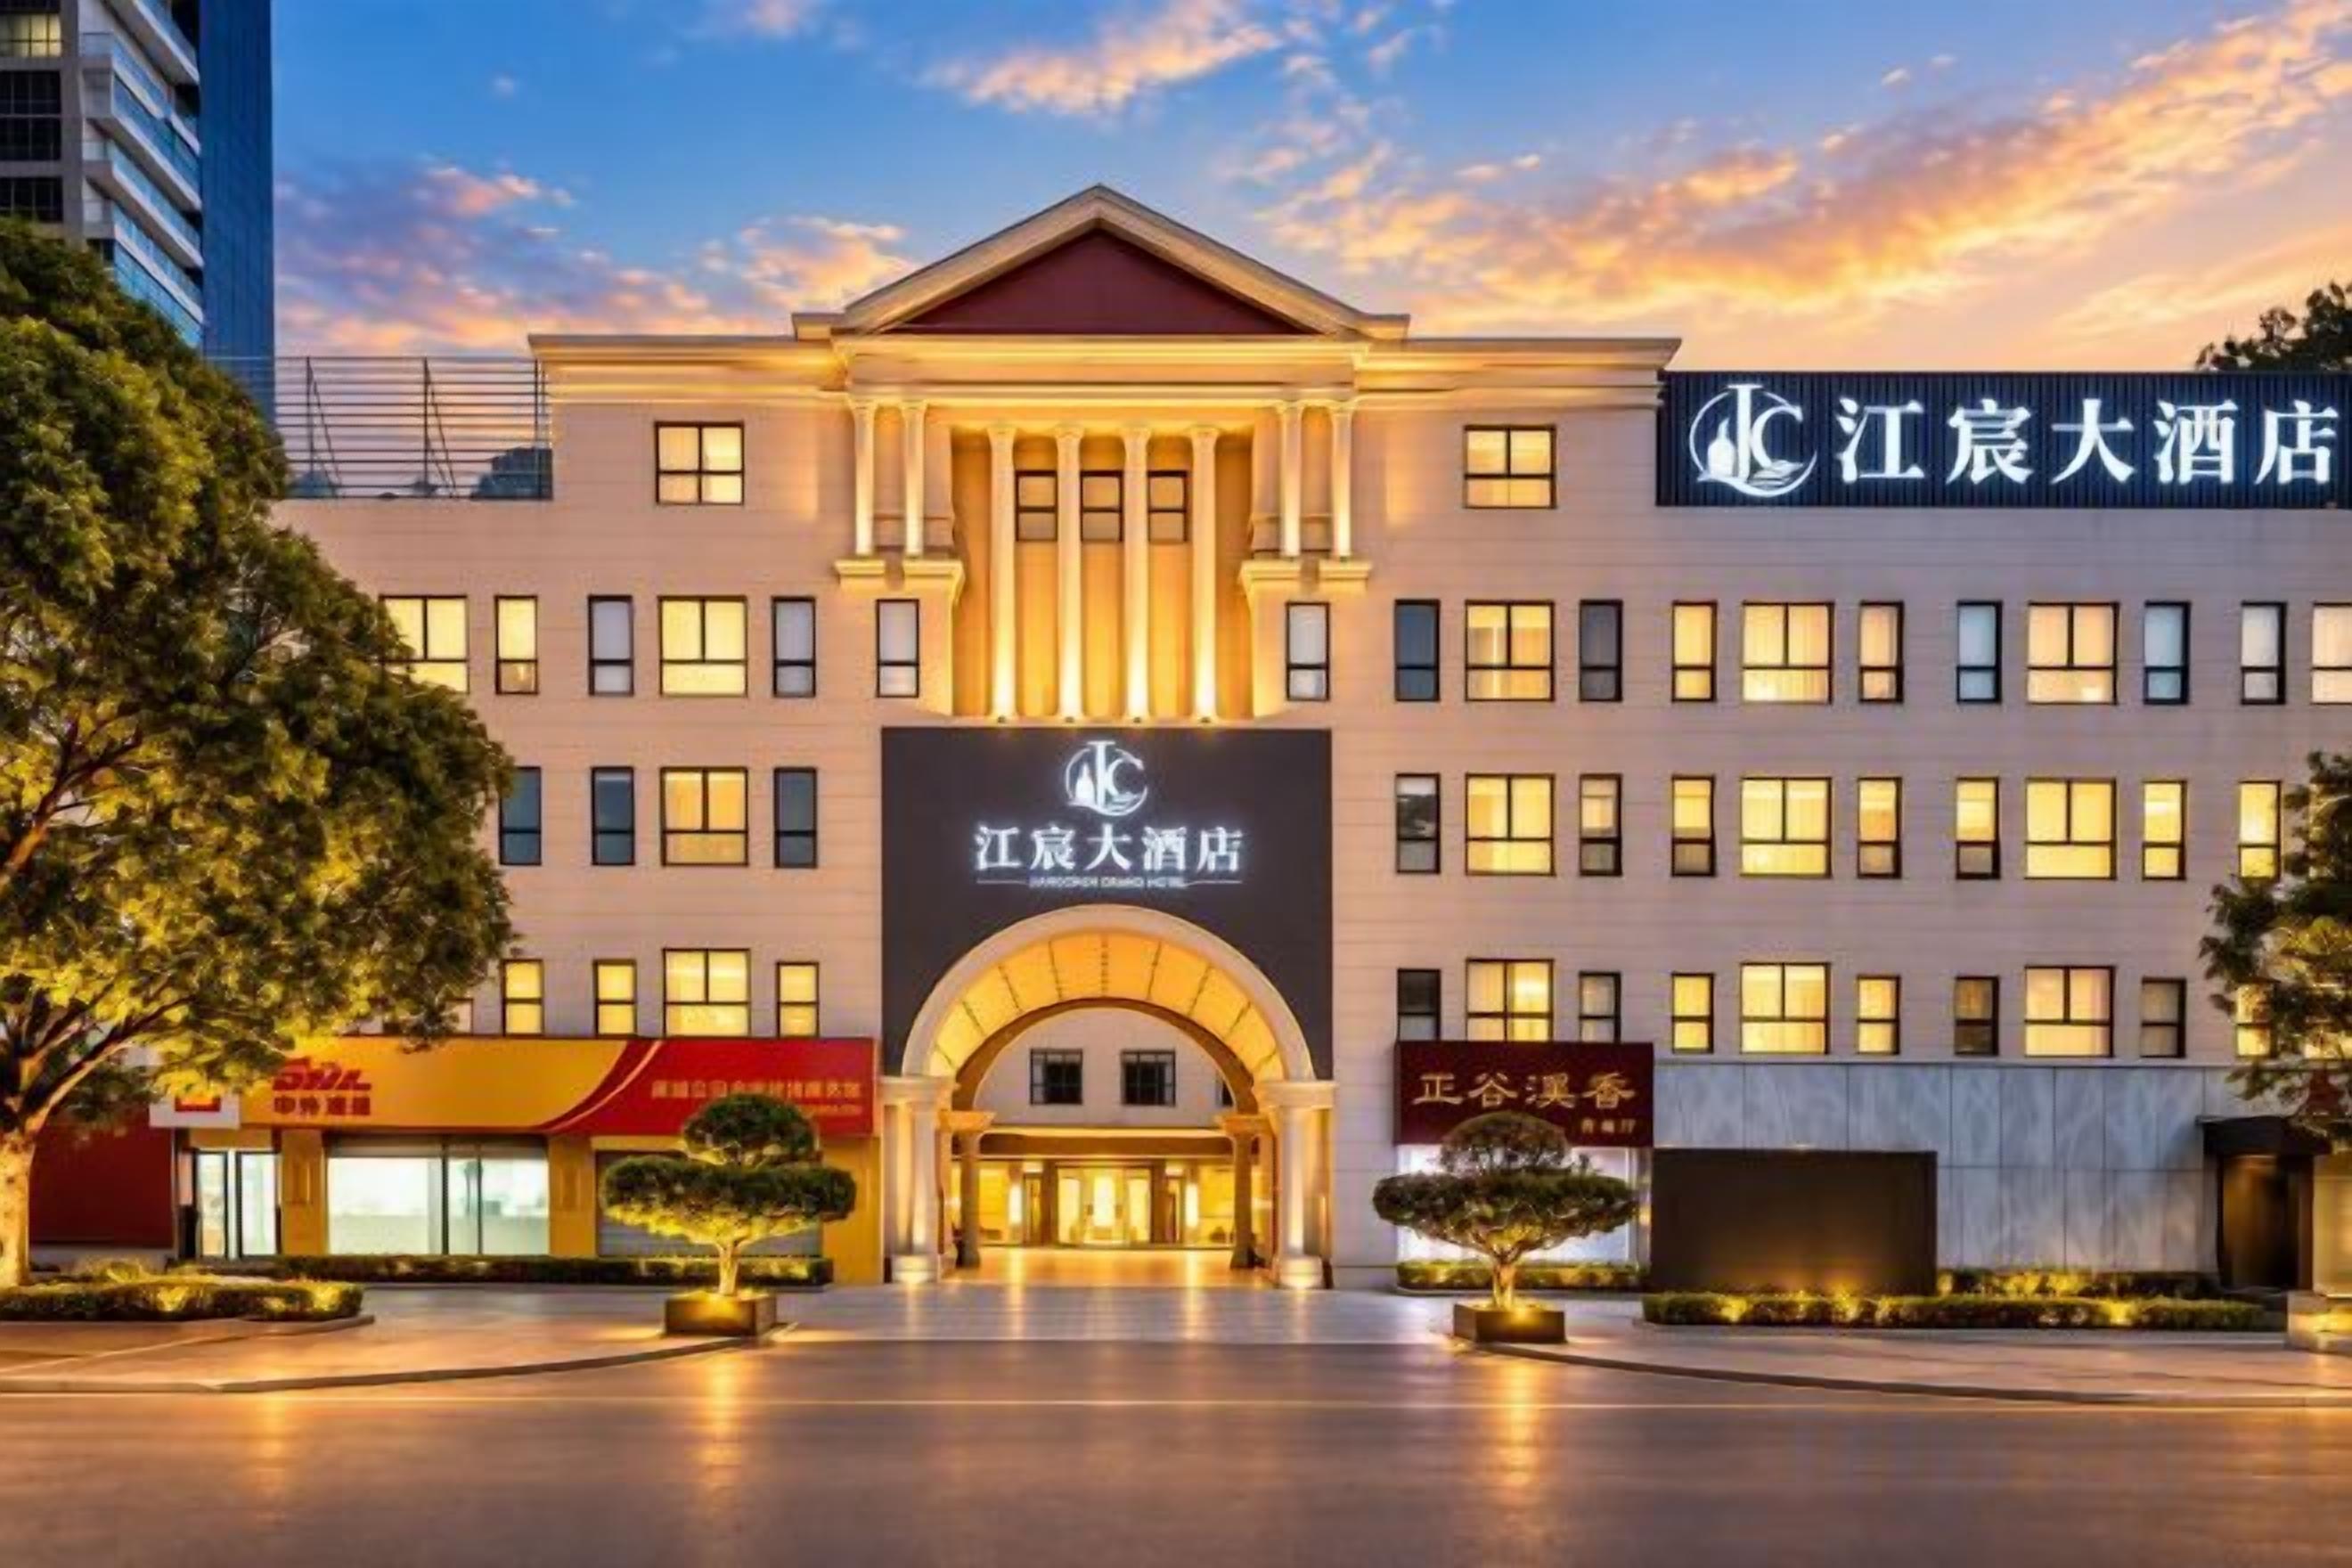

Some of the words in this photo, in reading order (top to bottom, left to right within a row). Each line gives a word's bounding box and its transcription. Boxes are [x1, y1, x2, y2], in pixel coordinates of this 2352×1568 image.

[1837, 397, 2340, 486] 江宸大酒店
[975, 824, 1244, 871] 江宸大酒店
